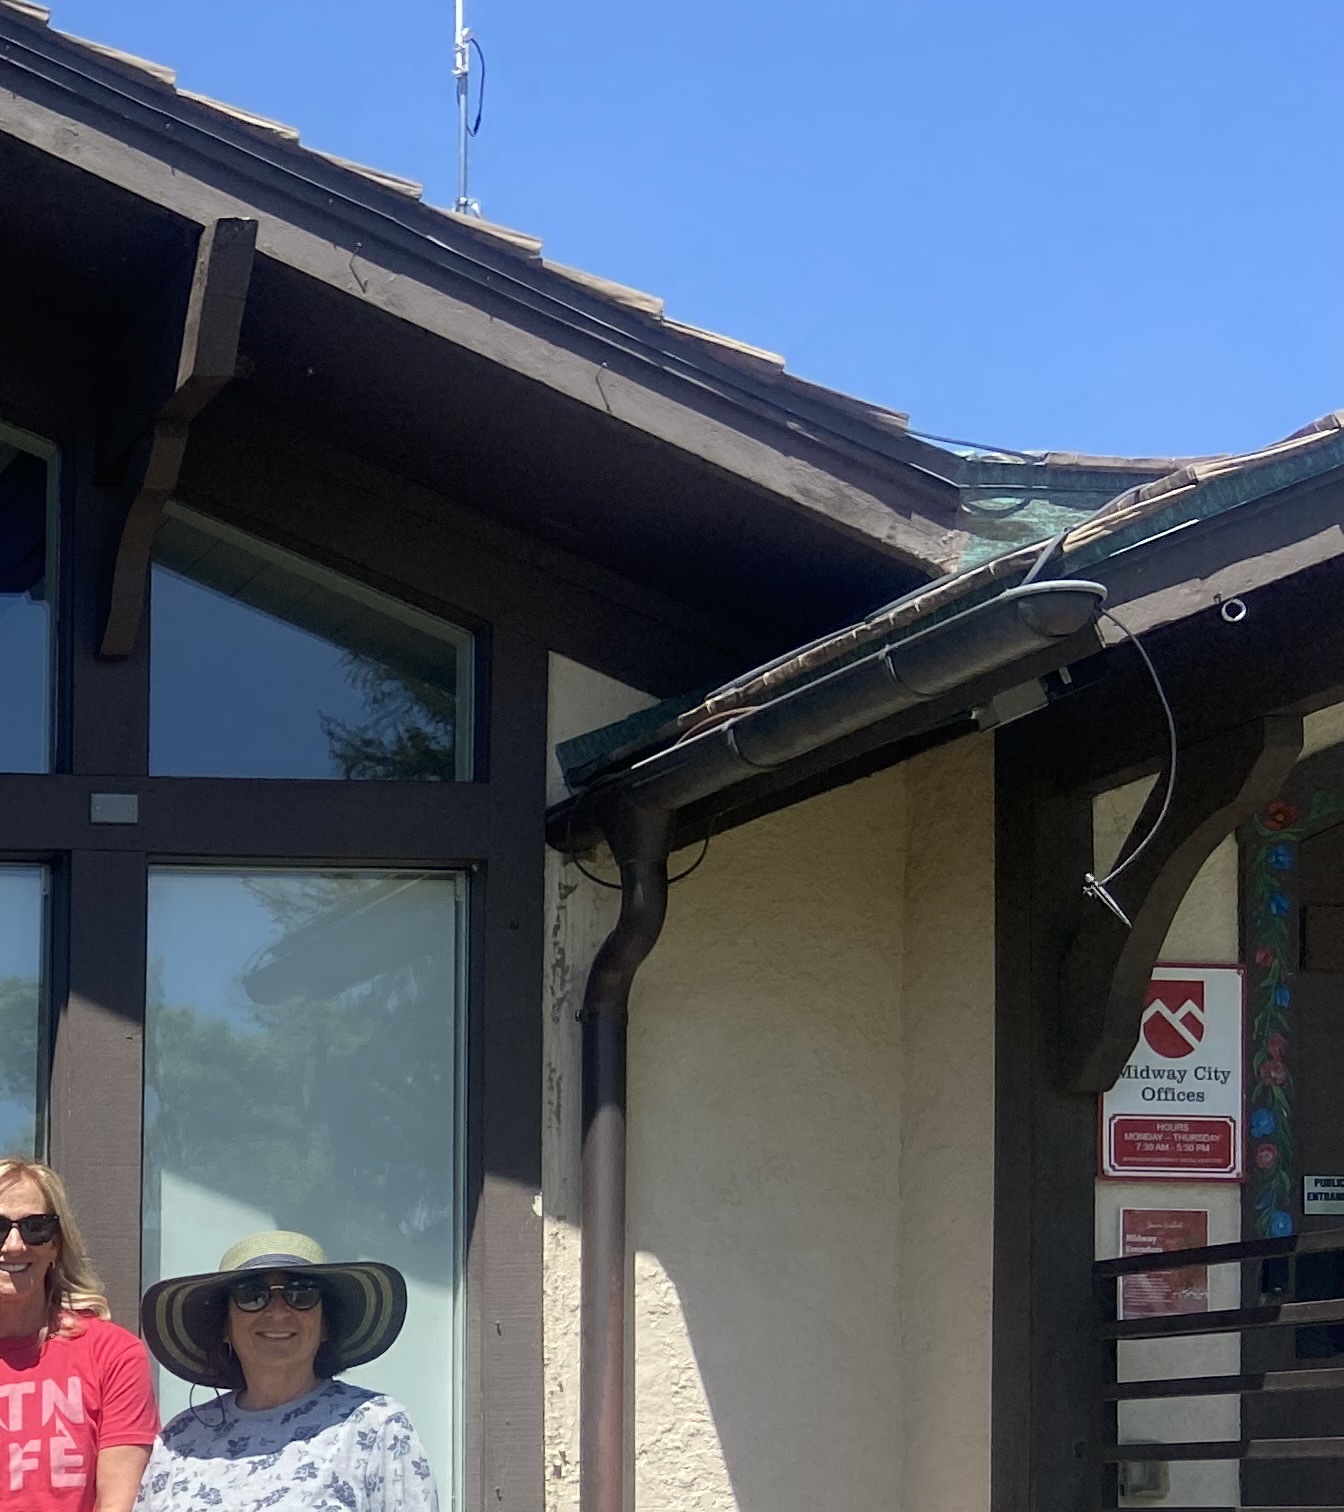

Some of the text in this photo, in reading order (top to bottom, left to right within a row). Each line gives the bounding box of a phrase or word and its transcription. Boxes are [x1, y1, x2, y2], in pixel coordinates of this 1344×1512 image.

[1120, 1065, 1231, 1085] Midway City
[1141, 1087, 1206, 1102] Offices
[1156, 1123, 1189, 1132] HOURS
[1124, 1132, 1164, 1141] MONDAY
[1172, 1133, 1221, 1142] THURSDAY
[1155, 1143, 1170, 1151] AM
[1196, 1144, 1210, 1152] PM
[1307, 1192, 1344, 1201] ENTRAN
